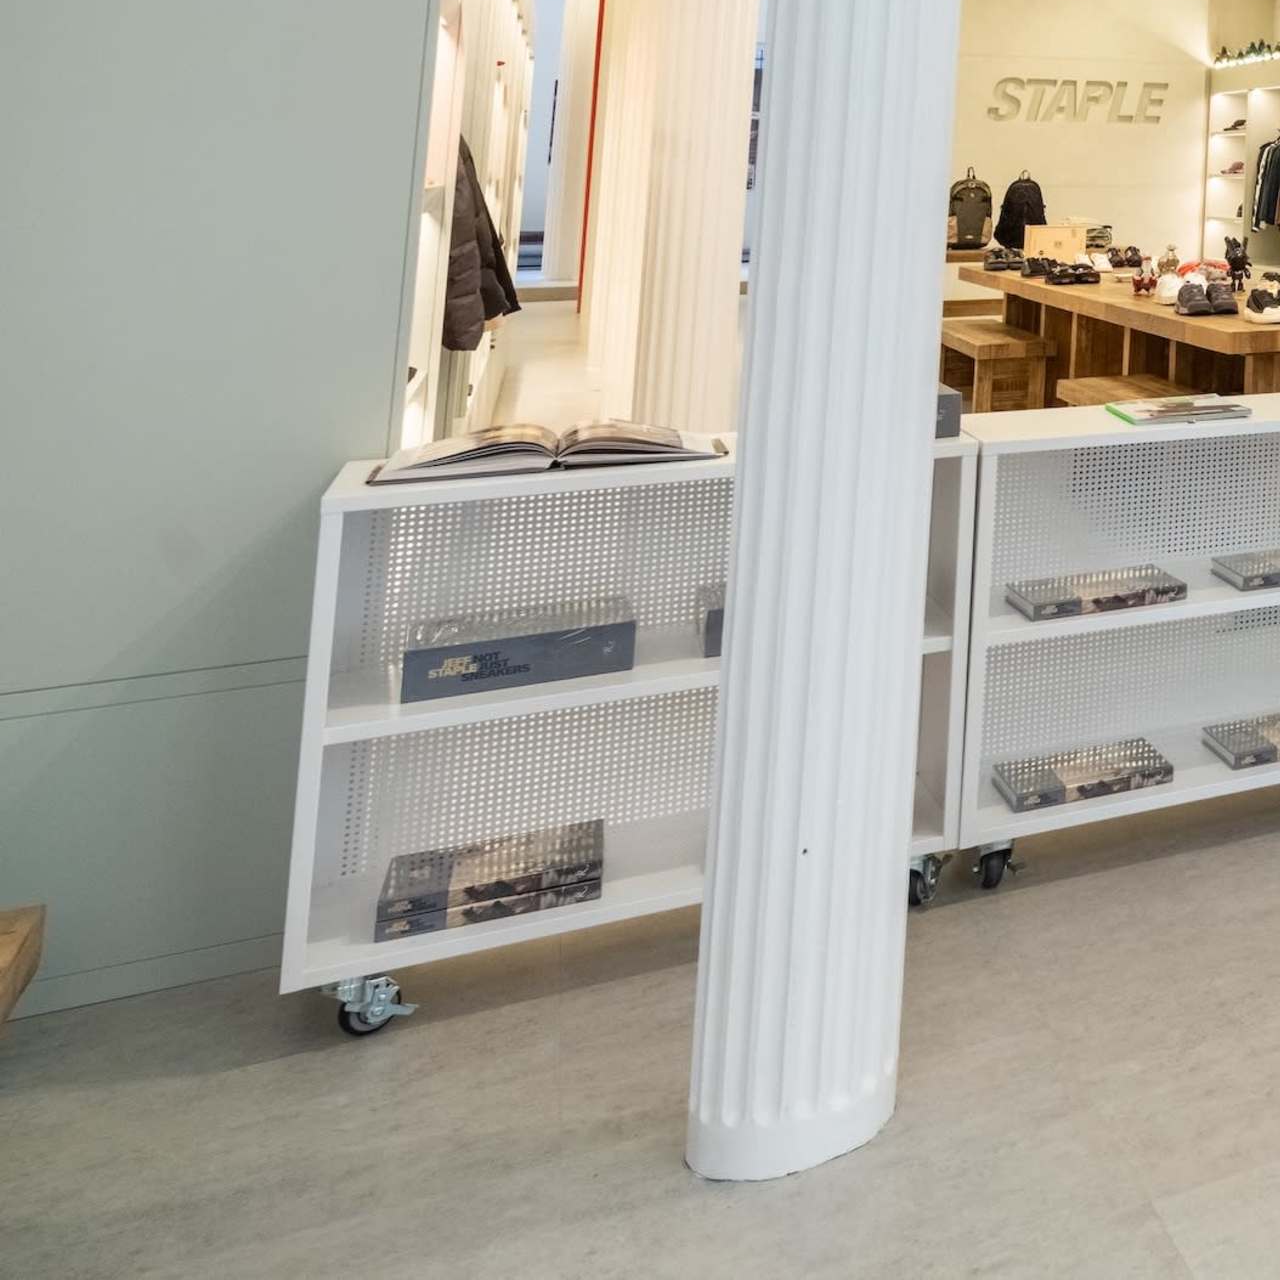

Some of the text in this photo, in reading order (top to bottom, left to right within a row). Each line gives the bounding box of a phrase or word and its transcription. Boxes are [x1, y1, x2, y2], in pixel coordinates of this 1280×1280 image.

[987, 77, 1169, 124] STAPLE
[443, 656, 472, 669] JEFF
[473, 651, 501, 664] NOT
[480, 658, 510, 671] JUST
[428, 664, 478, 679] STAPLE
[461, 663, 531, 682] SNEAKERS
